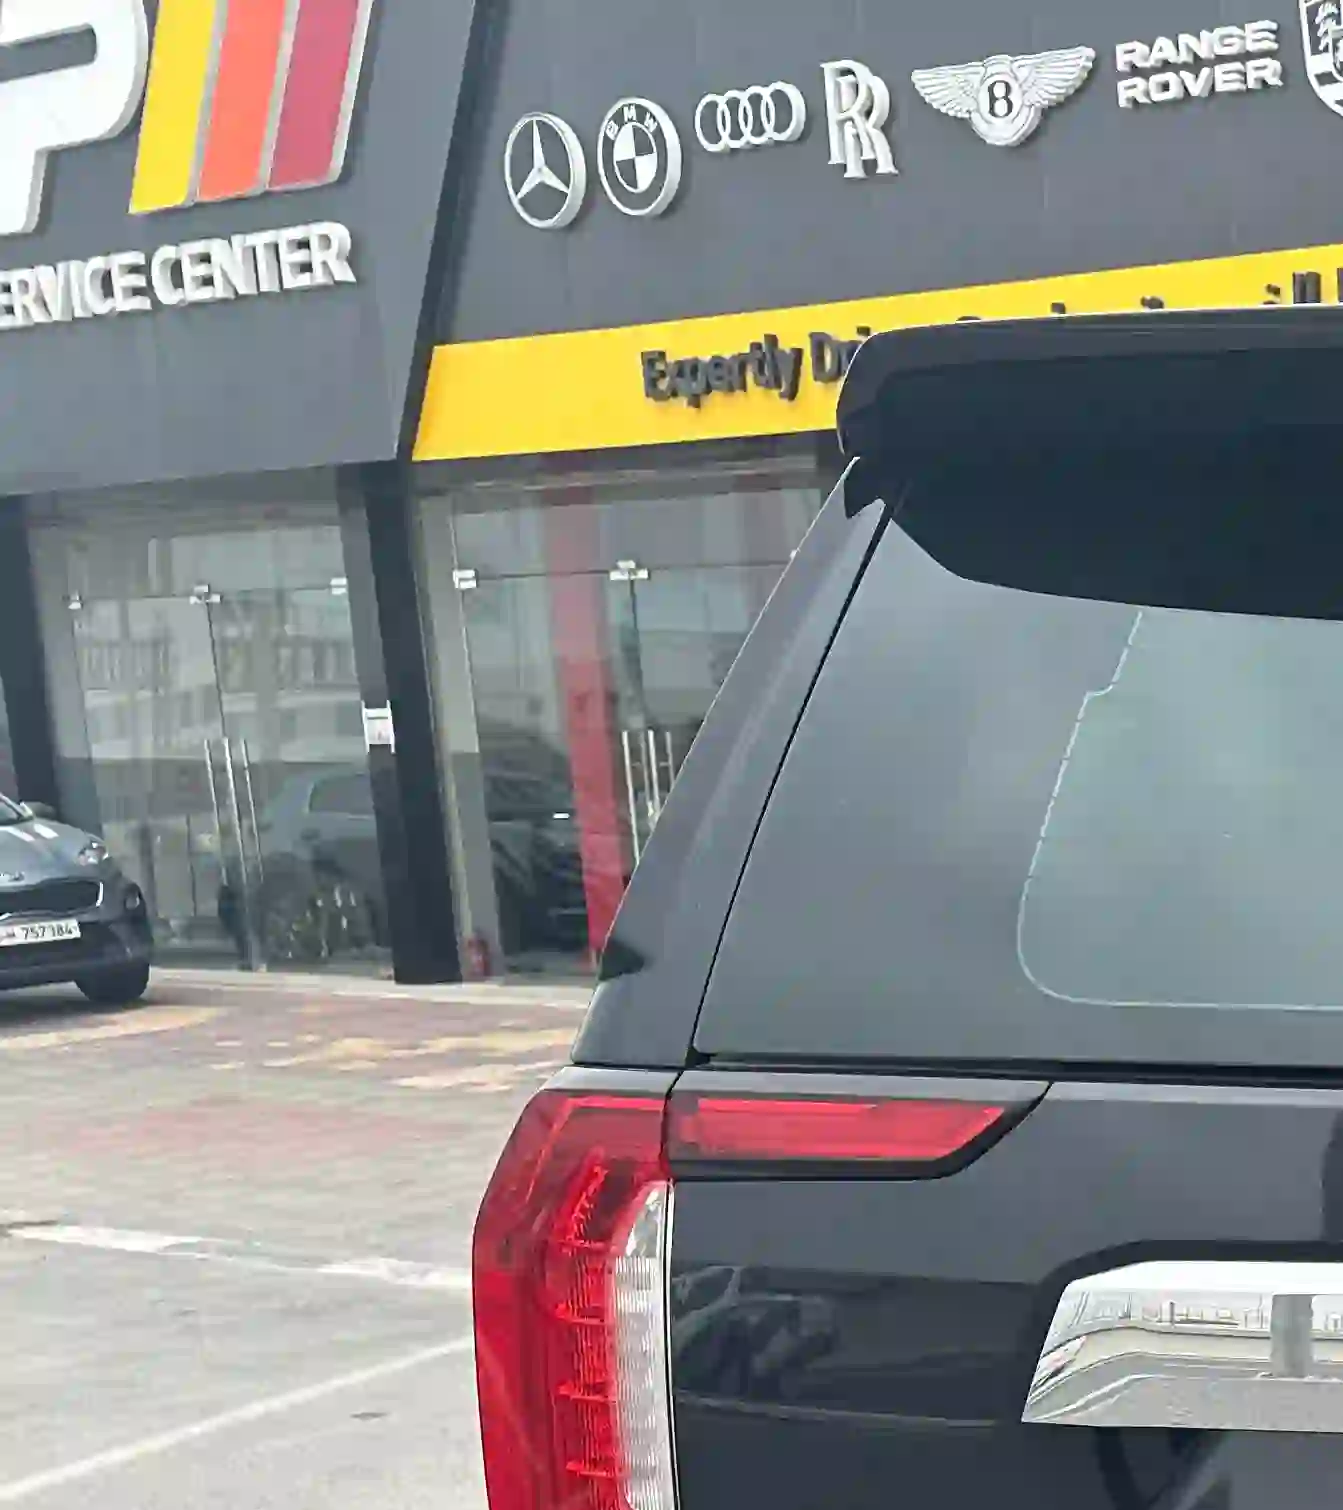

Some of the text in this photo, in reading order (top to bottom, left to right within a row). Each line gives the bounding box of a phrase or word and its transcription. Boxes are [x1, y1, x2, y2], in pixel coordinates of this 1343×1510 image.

[1115, 19, 1279, 72] RANGE
[1117, 56, 1284, 108] ROVER
[605, 103, 658, 141] BMW
[151, 221, 357, 306] CENTER
[641, 333, 803, 409] Expertly
